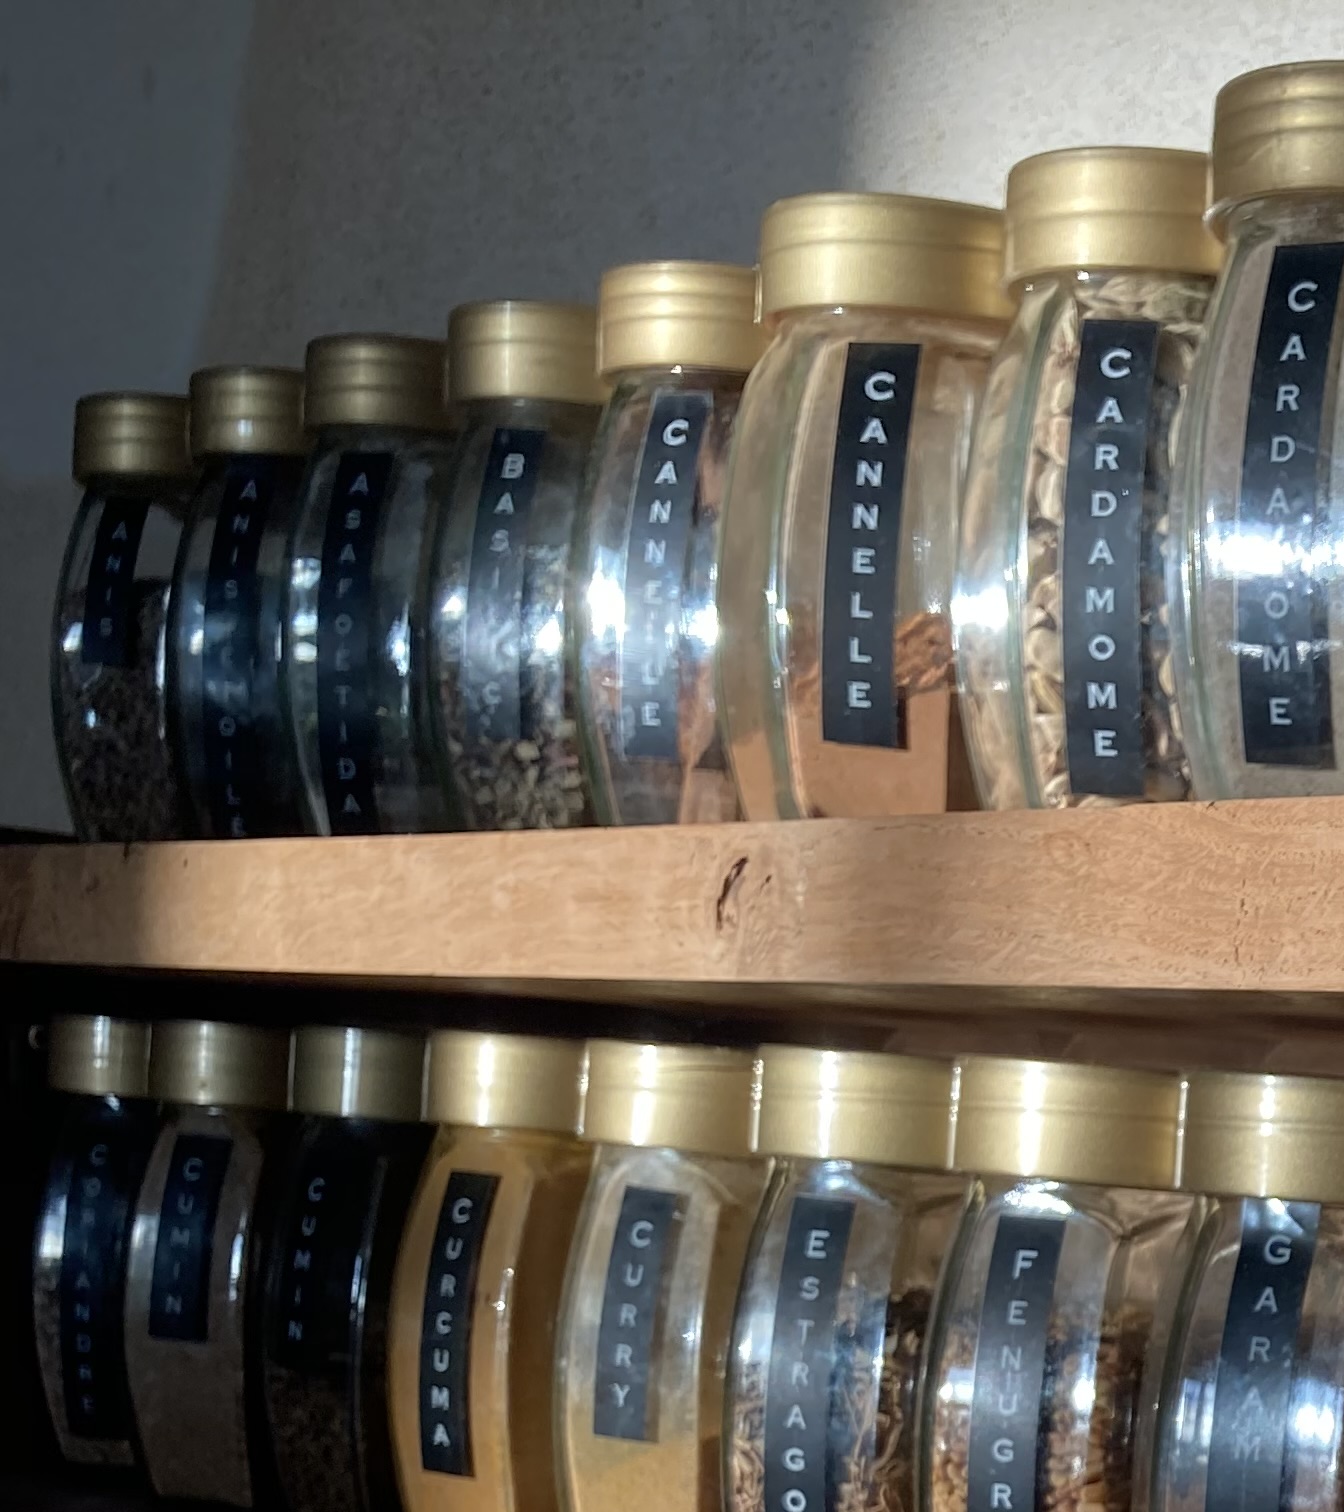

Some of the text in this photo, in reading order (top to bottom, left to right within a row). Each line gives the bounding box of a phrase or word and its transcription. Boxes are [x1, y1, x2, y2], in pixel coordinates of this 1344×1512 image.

[100, 521, 127, 636] ANIS
[223, 480, 257, 599] ANIS
[482, 454, 525, 706] BASIC
[848, 371, 898, 709] CANNELLE
[1085, 348, 1132, 757] CARDAMOME
[1263, 281, 1319, 726] CARDAOME
[165, 1157, 205, 1315] CUMIN
[288, 1176, 326, 1341] CUMIN
[430, 1197, 473, 1448] CURCUMA
[611, 1220, 655, 1407] CURRY
[1234, 1235, 1292, 1462] GARAM
